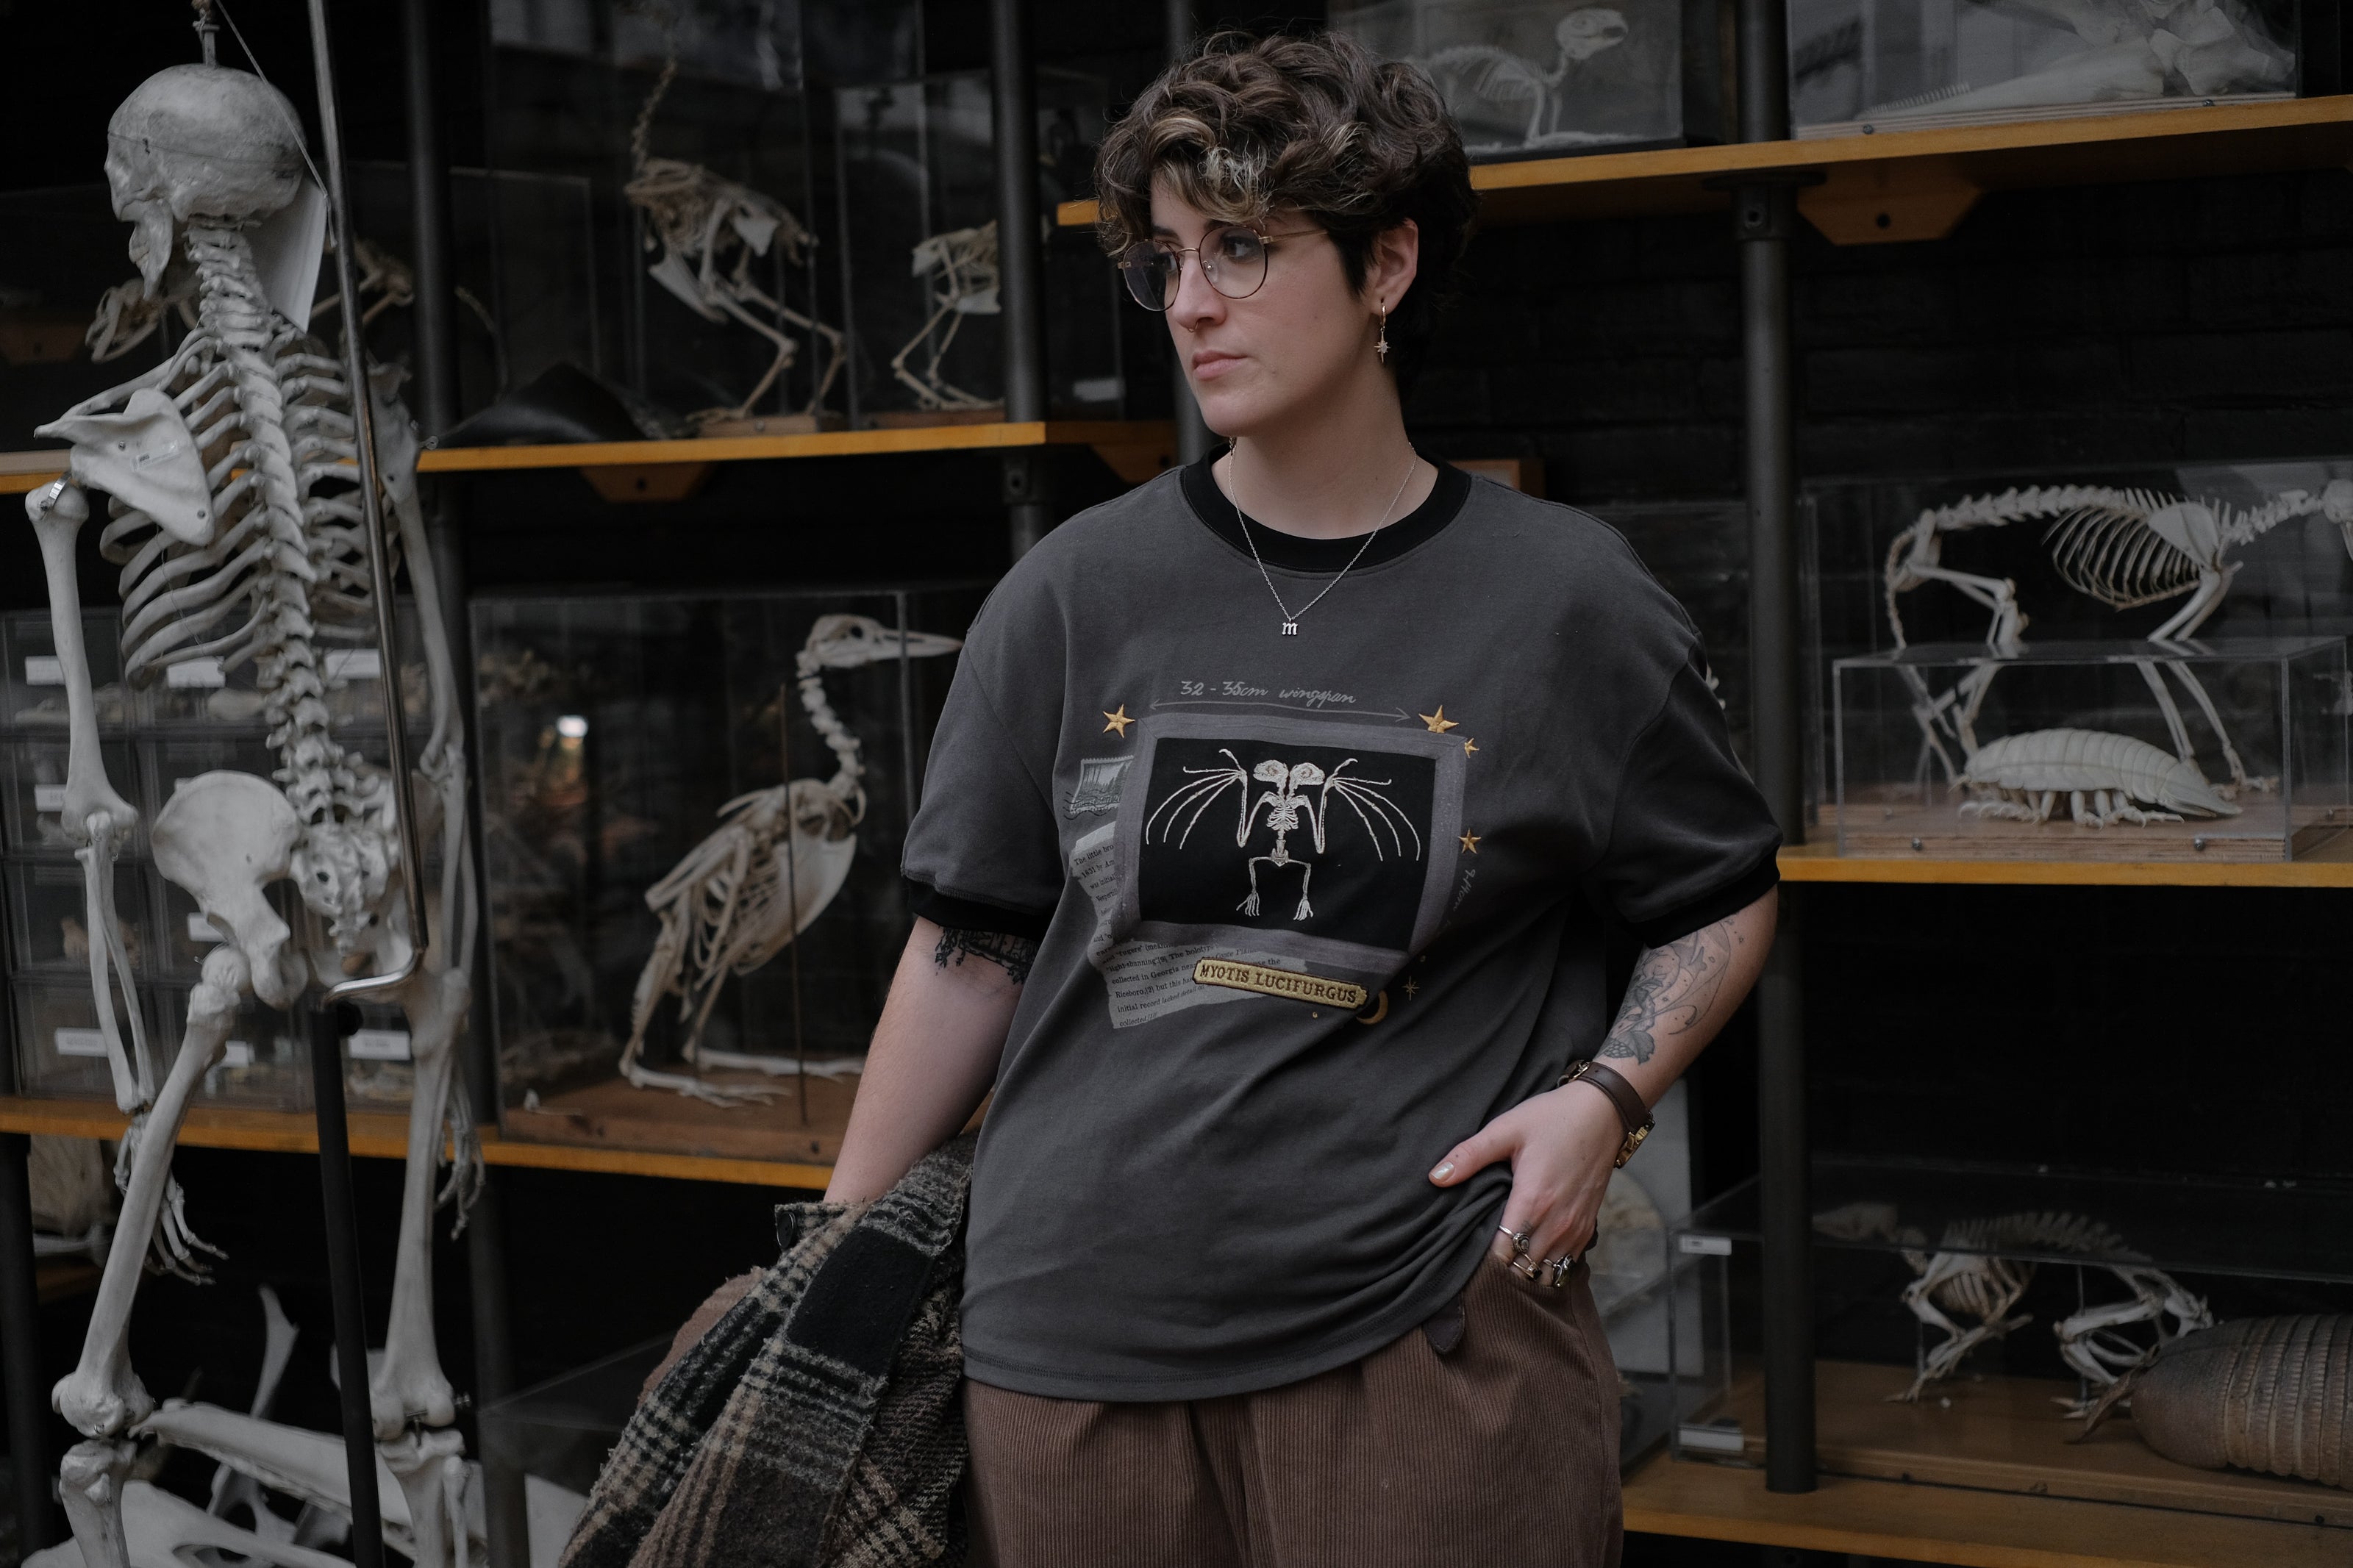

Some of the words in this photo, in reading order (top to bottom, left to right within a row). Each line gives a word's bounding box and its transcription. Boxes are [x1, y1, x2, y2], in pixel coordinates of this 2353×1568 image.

[1282, 622, 1299, 636] m
[1180, 681, 1204, 696] 32
[1222, 681, 1268, 696] 35cm
[1279, 687, 1356, 708] wingspan
[1074, 857, 1087, 865] The
[1086, 849, 1101, 859] little
[1168, 951, 1184, 960] The
[1186, 945, 1214, 956] holotyp
[1267, 957, 1281, 965] the
[1112, 975, 1140, 984] collected
[1141, 973, 1149, 981] in
[1151, 966, 1179, 978] Georgia
[1155, 984, 1168, 992] but
[1169, 980, 1181, 989] this
[1199, 964, 1251, 984] MYOTIS
[1254, 973, 1357, 1004] LUCIFURGUS
[1118, 1003, 1138, 1013] initial
[1139, 998, 1161, 1009] record
